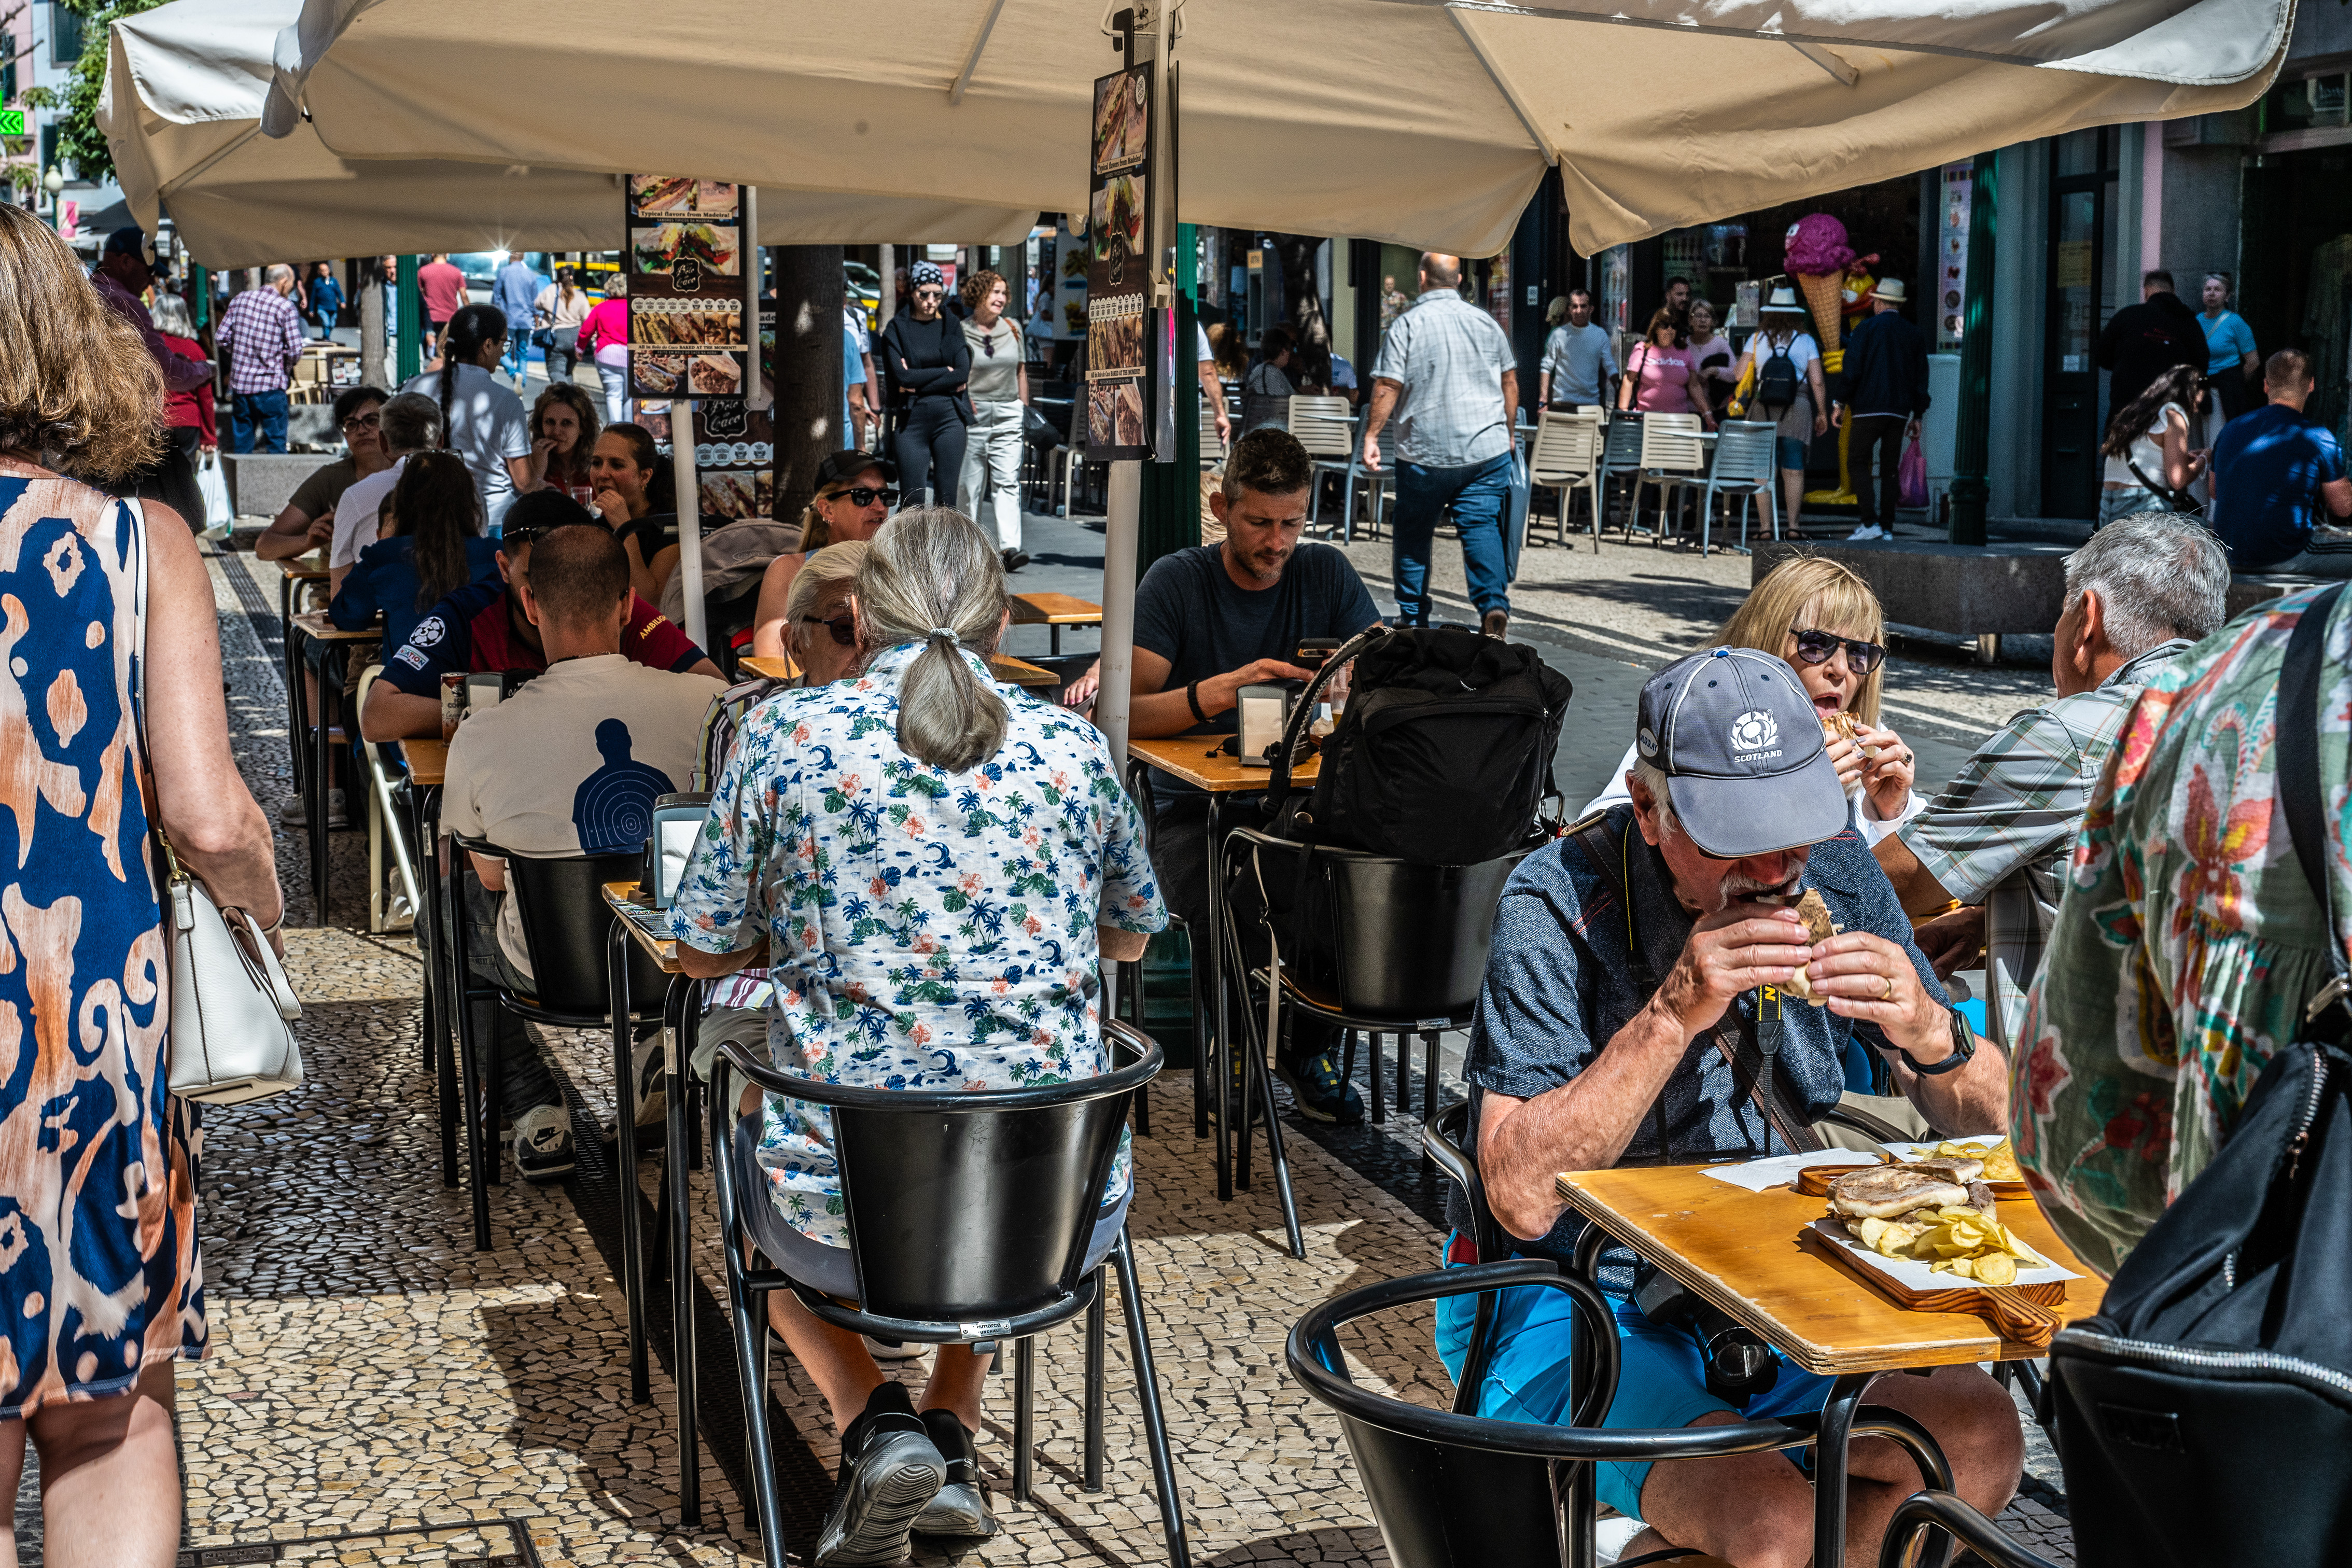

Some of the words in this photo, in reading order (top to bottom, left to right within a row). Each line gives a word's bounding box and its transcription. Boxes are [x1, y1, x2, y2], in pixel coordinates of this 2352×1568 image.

[1098, 162, 1109, 173] Typical
[1127, 154, 1141, 164] Madeira!
[1734, 749, 1783, 763] SCOTLAND
[540, 1143, 559, 1152] AIR
